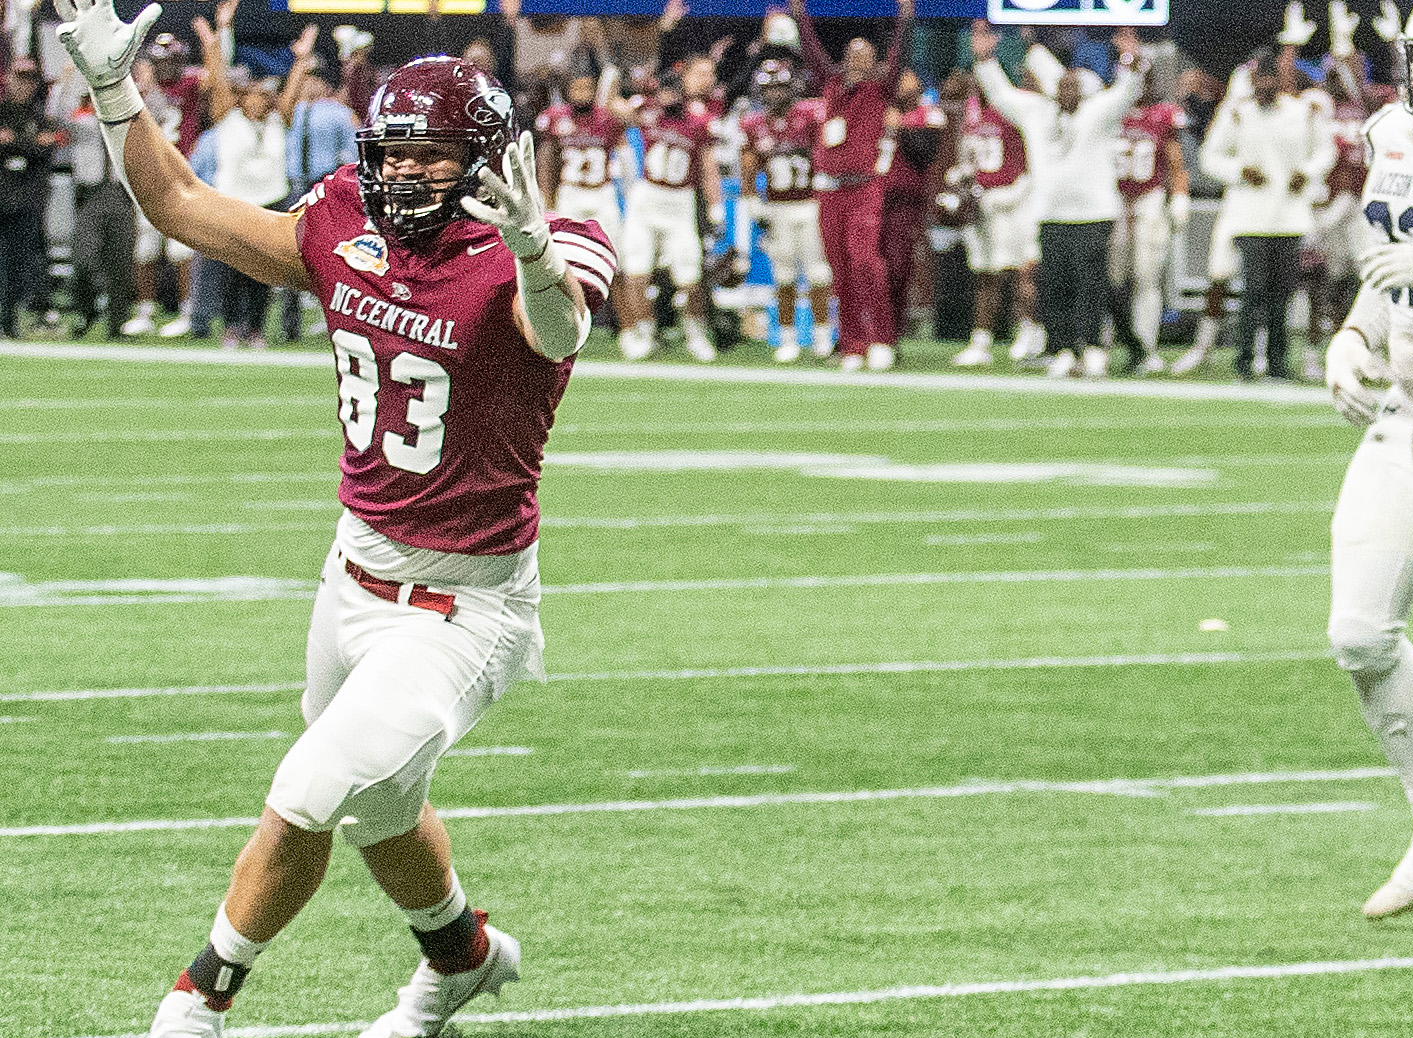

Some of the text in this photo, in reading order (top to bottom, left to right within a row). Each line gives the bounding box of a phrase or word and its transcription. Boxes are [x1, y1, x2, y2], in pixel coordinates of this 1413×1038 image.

[329, 281, 459, 350] NC CENTRAL
[331, 328, 451, 475] 83
